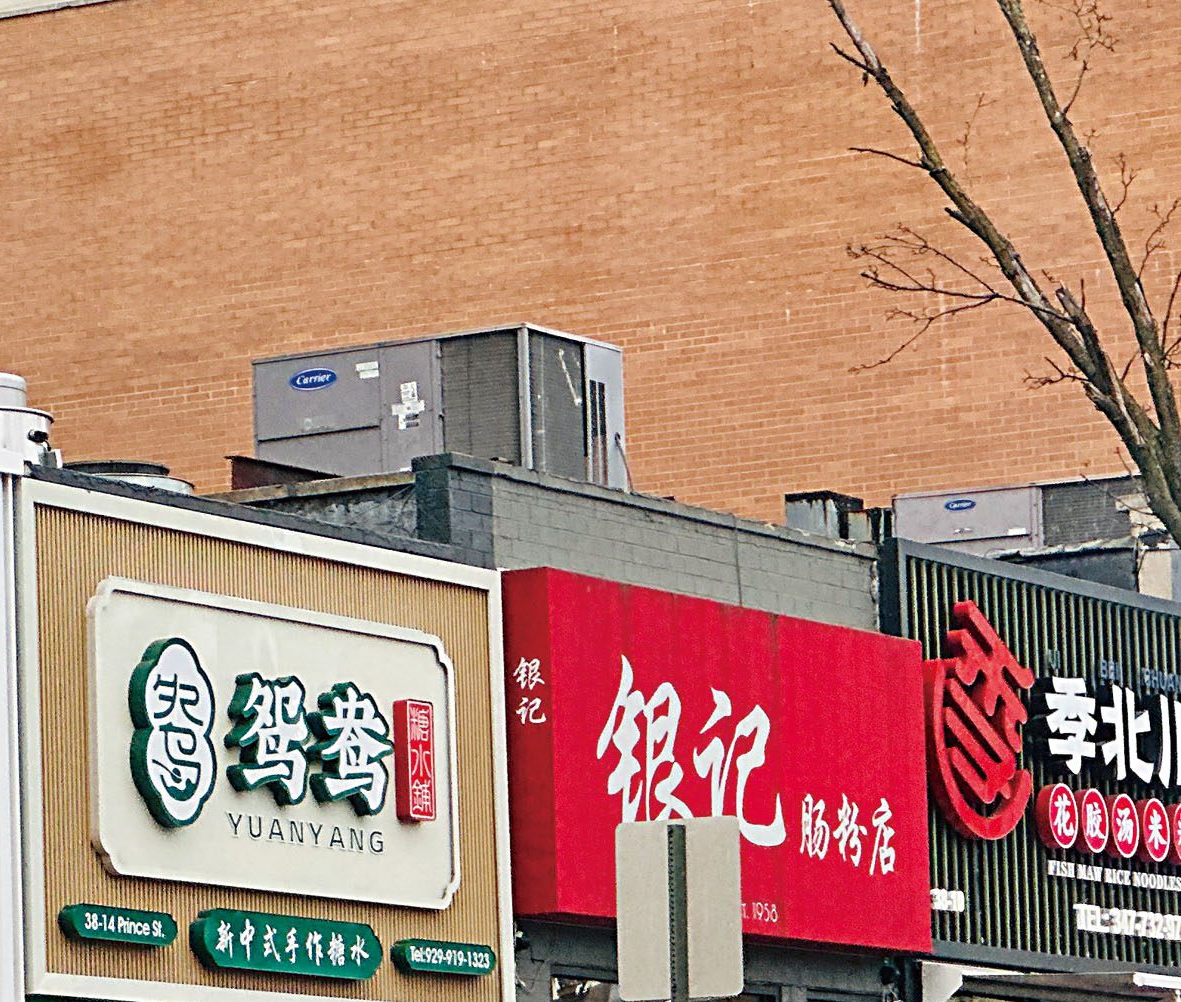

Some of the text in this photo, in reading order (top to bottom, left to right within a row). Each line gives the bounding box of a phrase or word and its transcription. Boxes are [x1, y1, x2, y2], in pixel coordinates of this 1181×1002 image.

[296, 373, 332, 385] Carrier
[513, 656, 546, 725] 银记
[231, 672, 394, 815] 鸳鸯
[596, 655, 786, 847] 银记
[227, 812, 385, 854] YUANYANG
[800, 792, 896, 876] 肠粉店
[1053, 792, 1181, 851] 花胶汤米
[1047, 859, 1076, 879] FISH
[1077, 864, 1103, 882] MAW
[1104, 868, 1131, 886] RICE
[84, 911, 167, 938] 38-14 Prince St.
[752, 901, 779, 923] 1958
[215, 918, 370, 968] 新中式手作糖水
[409, 945, 491, 970] Tel:929-919-1323
